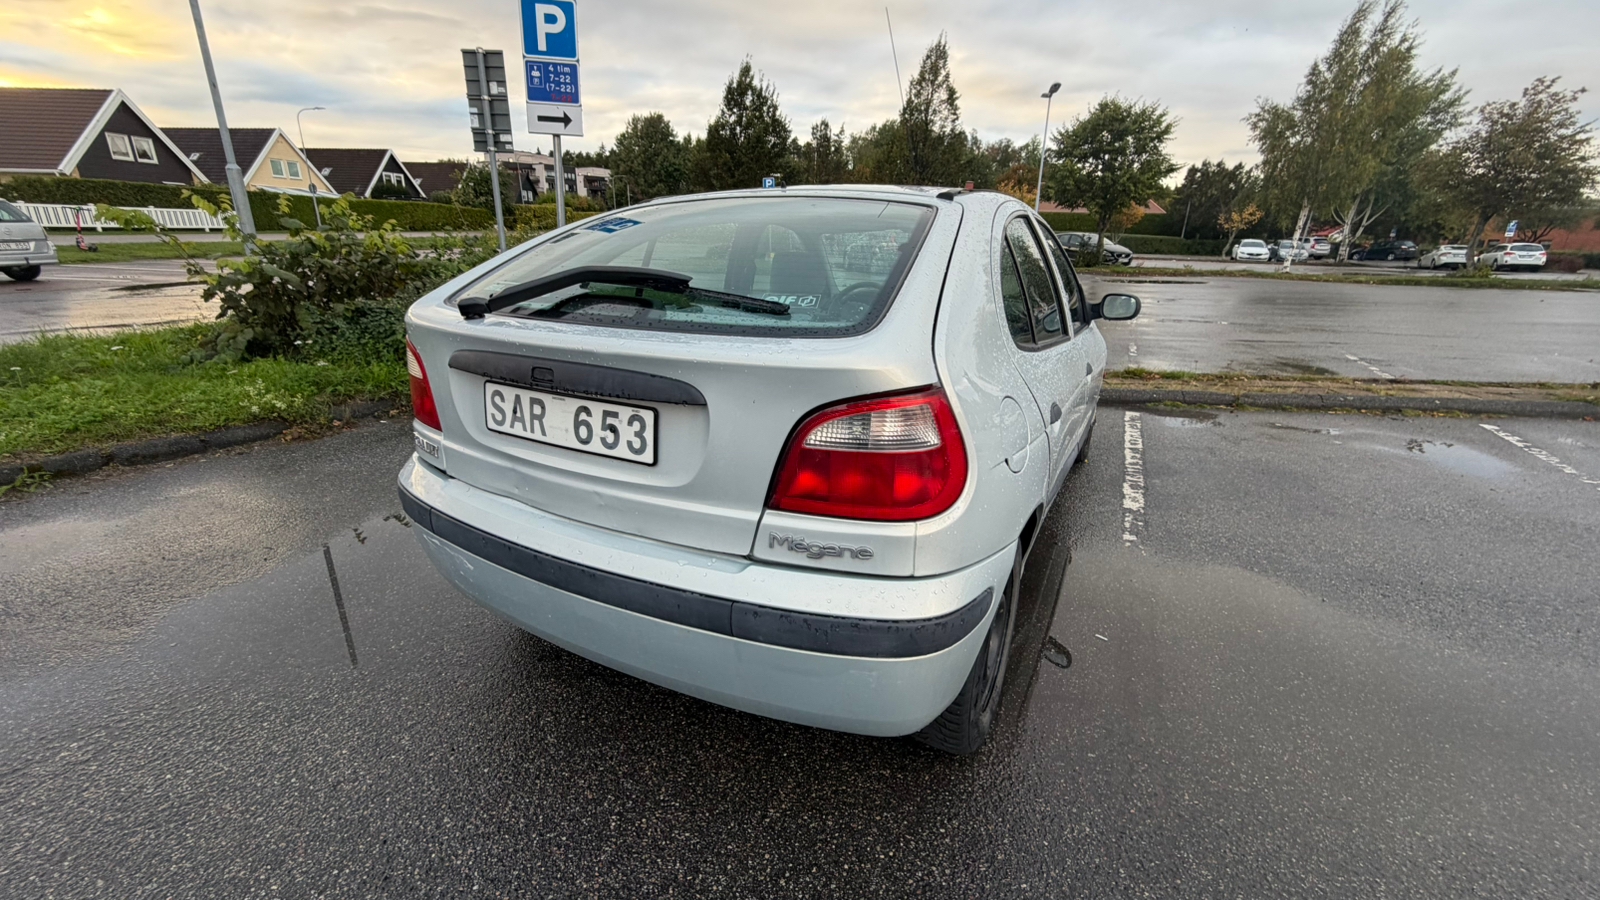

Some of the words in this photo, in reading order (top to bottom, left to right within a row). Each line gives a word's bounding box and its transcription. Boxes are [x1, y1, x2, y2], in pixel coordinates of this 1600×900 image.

[535, 3, 566, 51] P
[548, 64, 554, 72] 4
[557, 65, 571, 73] tim
[549, 74, 571, 83] 7-22
[546, 83, 575, 93] (7-22)
[765, 180, 773, 188] P
[490, 389, 547, 437] SAR
[573, 405, 648, 456] 653
[769, 532, 875, 560] Mégane
